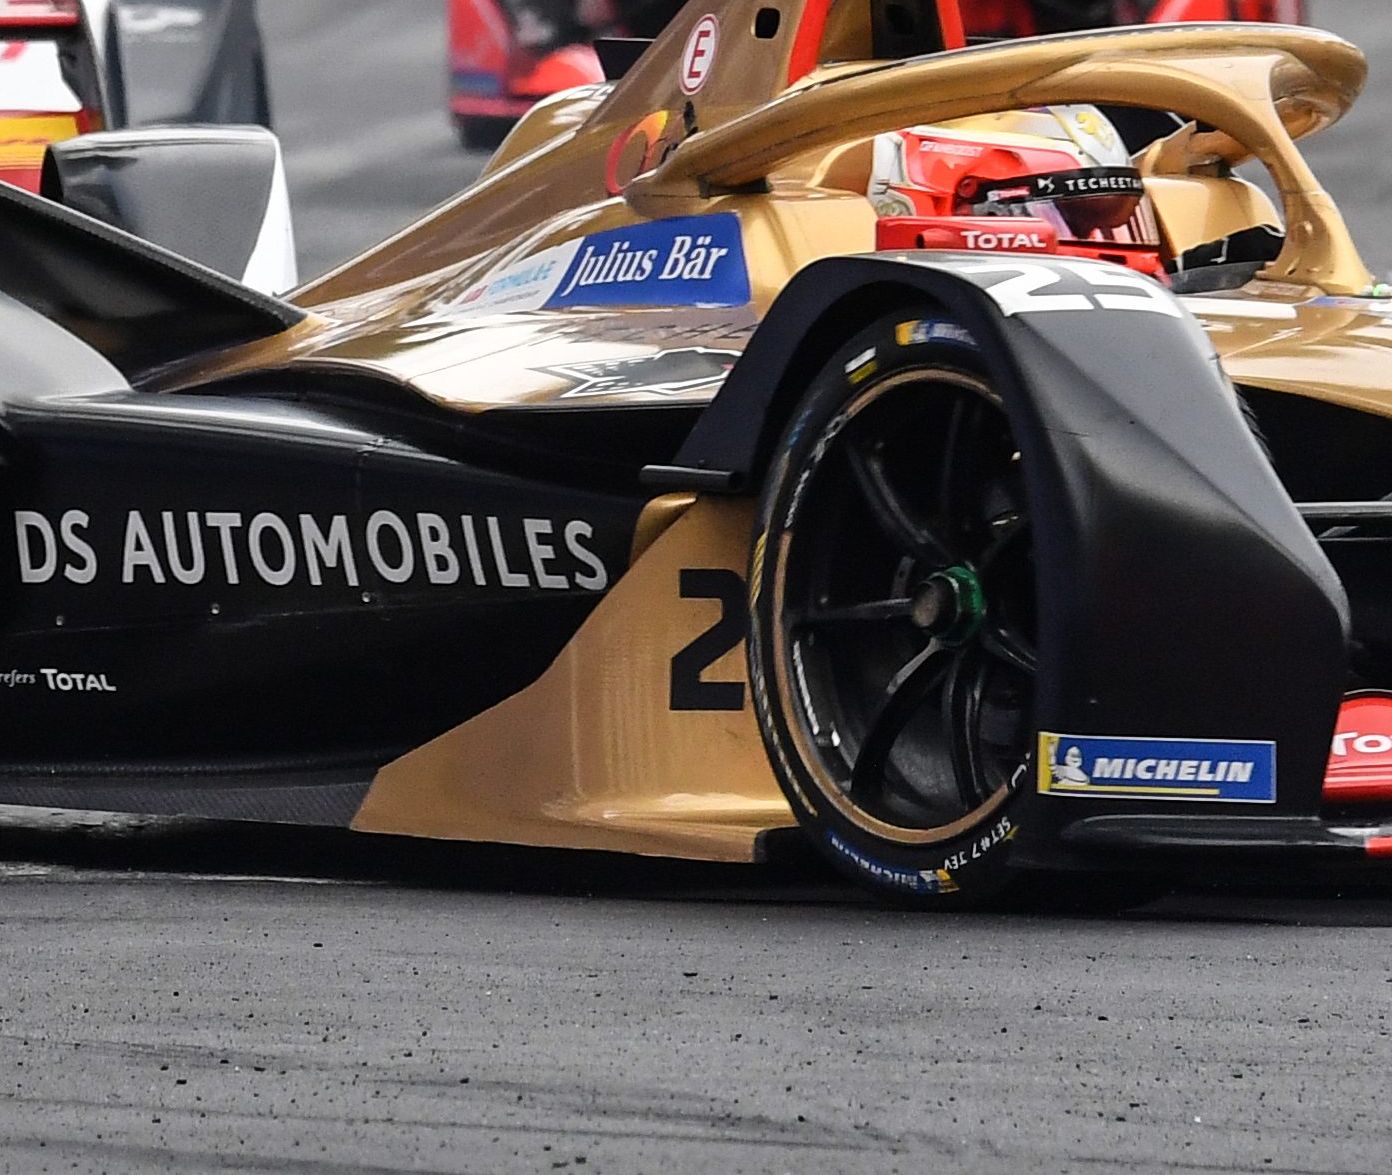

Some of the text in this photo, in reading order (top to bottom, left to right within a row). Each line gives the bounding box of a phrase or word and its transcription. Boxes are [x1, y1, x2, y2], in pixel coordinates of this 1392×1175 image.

[959, 230, 1048, 250] TOTAL
[560, 239, 659, 298] Julius
[658, 234, 729, 281] Bär
[14, 509, 609, 591] DS AUTOMOBILES
[39, 668, 118, 692] TOTAL
[1092, 755, 1255, 783] MICHELIN
[943, 851, 968, 871] JEV
